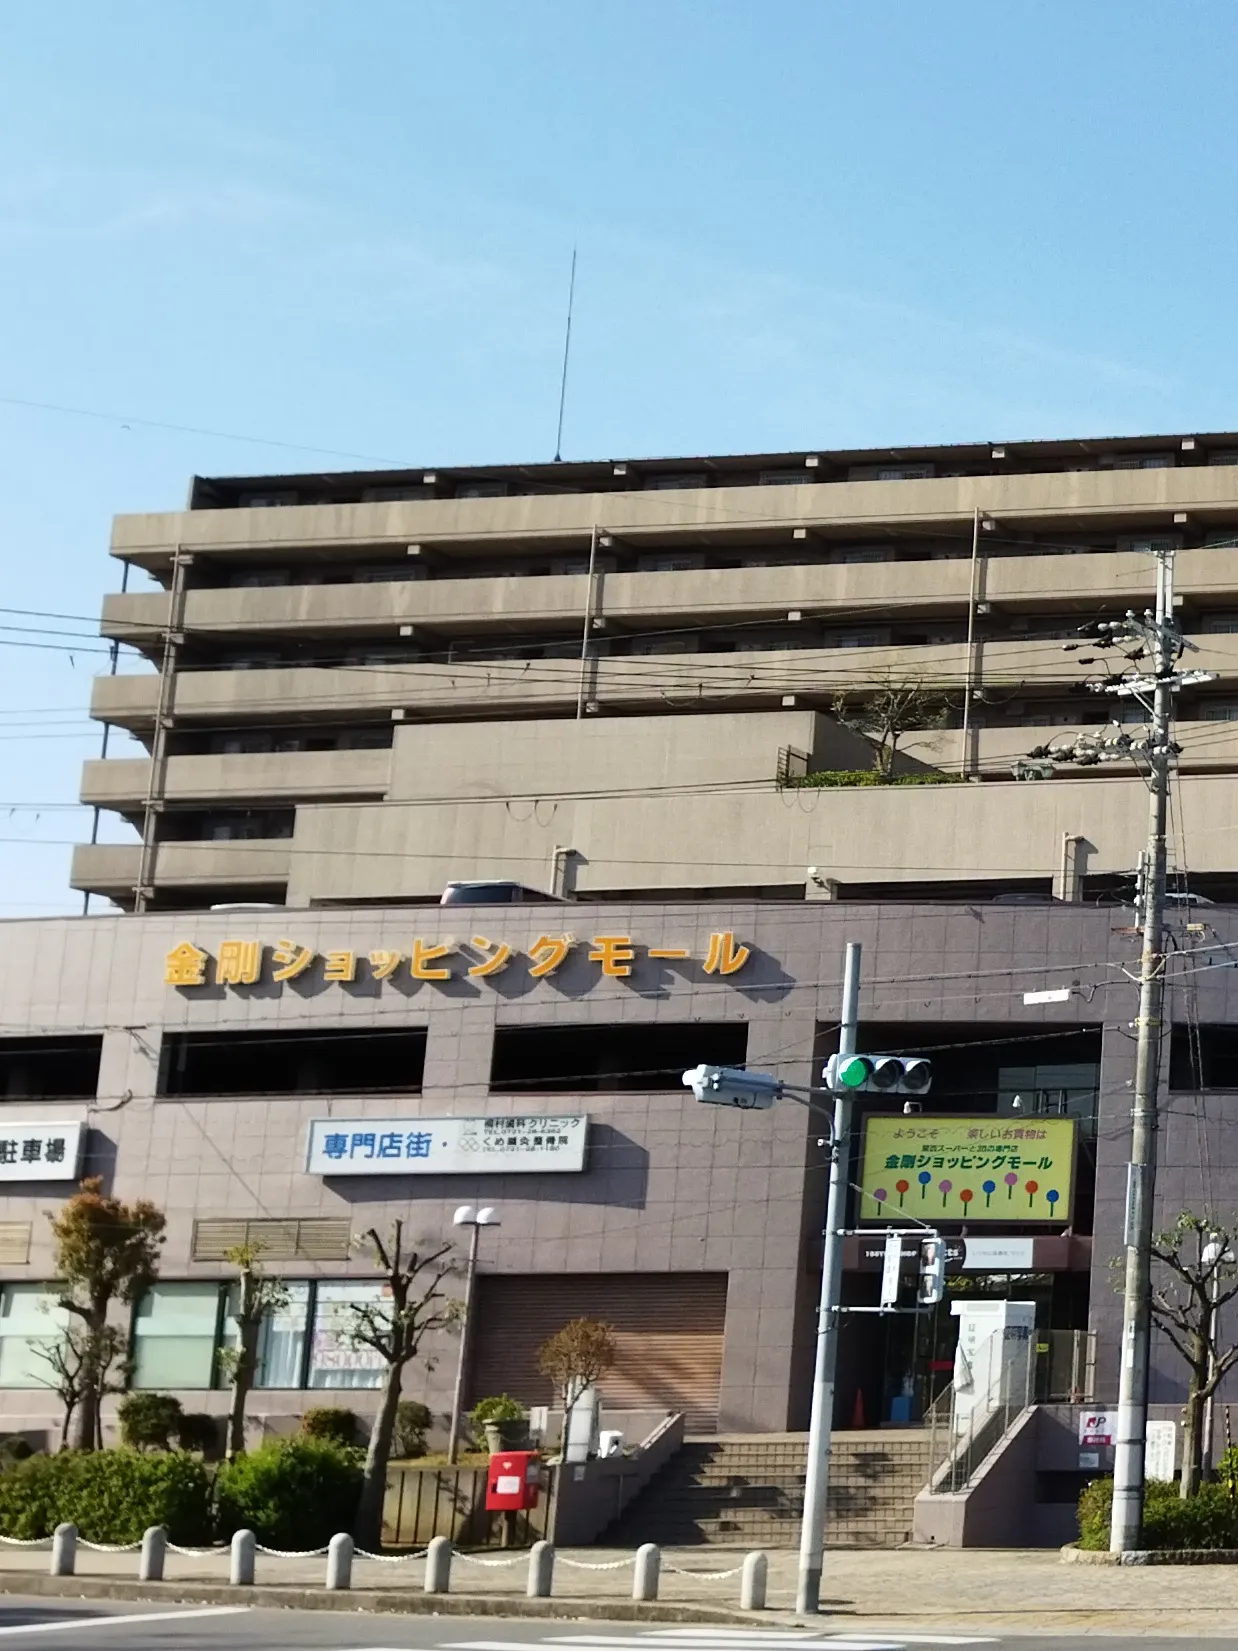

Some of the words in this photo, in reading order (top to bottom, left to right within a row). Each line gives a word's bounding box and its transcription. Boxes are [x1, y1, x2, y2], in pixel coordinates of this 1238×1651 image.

[164, 931, 749, 985] 金剛ショッピングモール
[893, 1128, 939, 1139] ようこそ
[884, 1154, 1053, 1170] 金剛ショッピングモール
